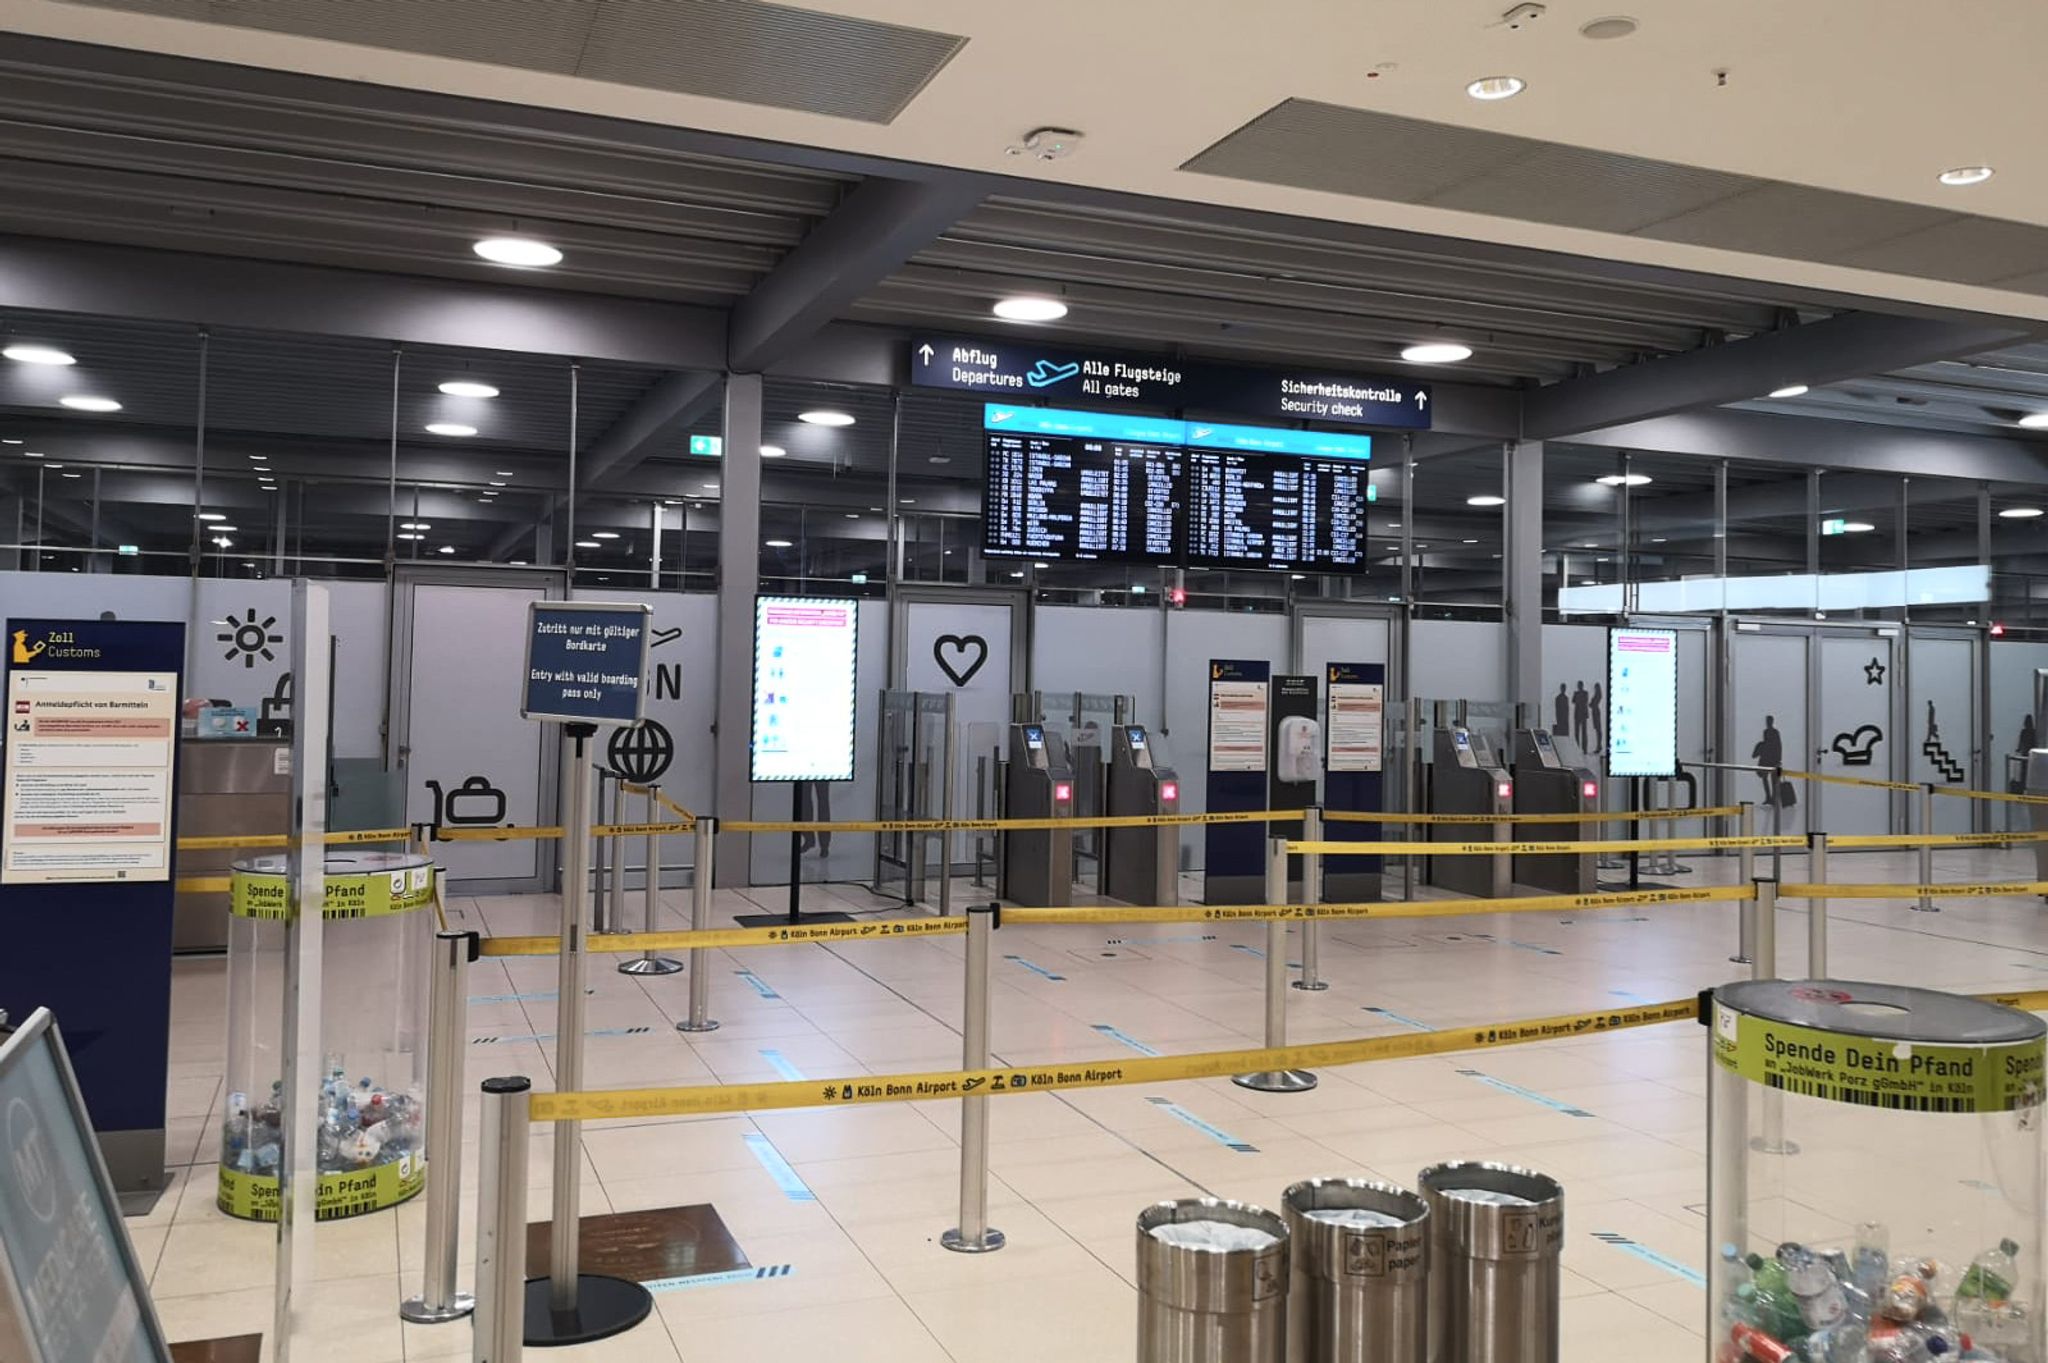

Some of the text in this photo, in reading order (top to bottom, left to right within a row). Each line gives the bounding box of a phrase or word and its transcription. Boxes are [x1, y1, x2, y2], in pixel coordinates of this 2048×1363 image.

[953, 348, 997, 369] Abflug
[953, 368, 1023, 388] Departures
[1083, 361, 1181, 386] Alle Flugsteige
[1083, 379, 1139, 398] All gates
[1281, 379, 1401, 403] Sicherheitskontrolle
[1281, 398, 1363, 417] Security check
[48, 632, 74, 643] Zoll
[537, 622, 640, 640] Zutritt nur mit gültiger
[48, 646, 101, 658] Customs
[566, 639, 607, 651] Bordkarte
[531, 669, 638, 688] Entry with valid boarding
[562, 688, 602, 701] pass only
[247, 883, 284, 899] Spende
[325, 884, 365, 898] Pfand
[791, 927, 858, 938] Köln Bonn Airport
[925, 923, 942, 931] Bonn
[1623, 1006, 1690, 1023] Köln Bonn Airport
[1499, 1023, 1571, 1041] Köln Bonn Airport
[1765, 1033, 1836, 1064] Spende
[1847, 1049, 1899, 1072] Dein
[1911, 1055, 1973, 1077] Pfand
[1030, 1068, 1122, 1086] Köln Bonn Airport
[1840, 1071, 1867, 1086] Porz
[1930, 1083, 1943, 1093] in
[1947, 1083, 1974, 1093] Köln
[857, 1080, 957, 1098] Köln Bonn Airport
[251, 1183, 280, 1199] Spen
[339, 1172, 377, 1193] Pfand
[1386, 1237, 1422, 1253] Papier
[1388, 1254, 1421, 1272] paper
